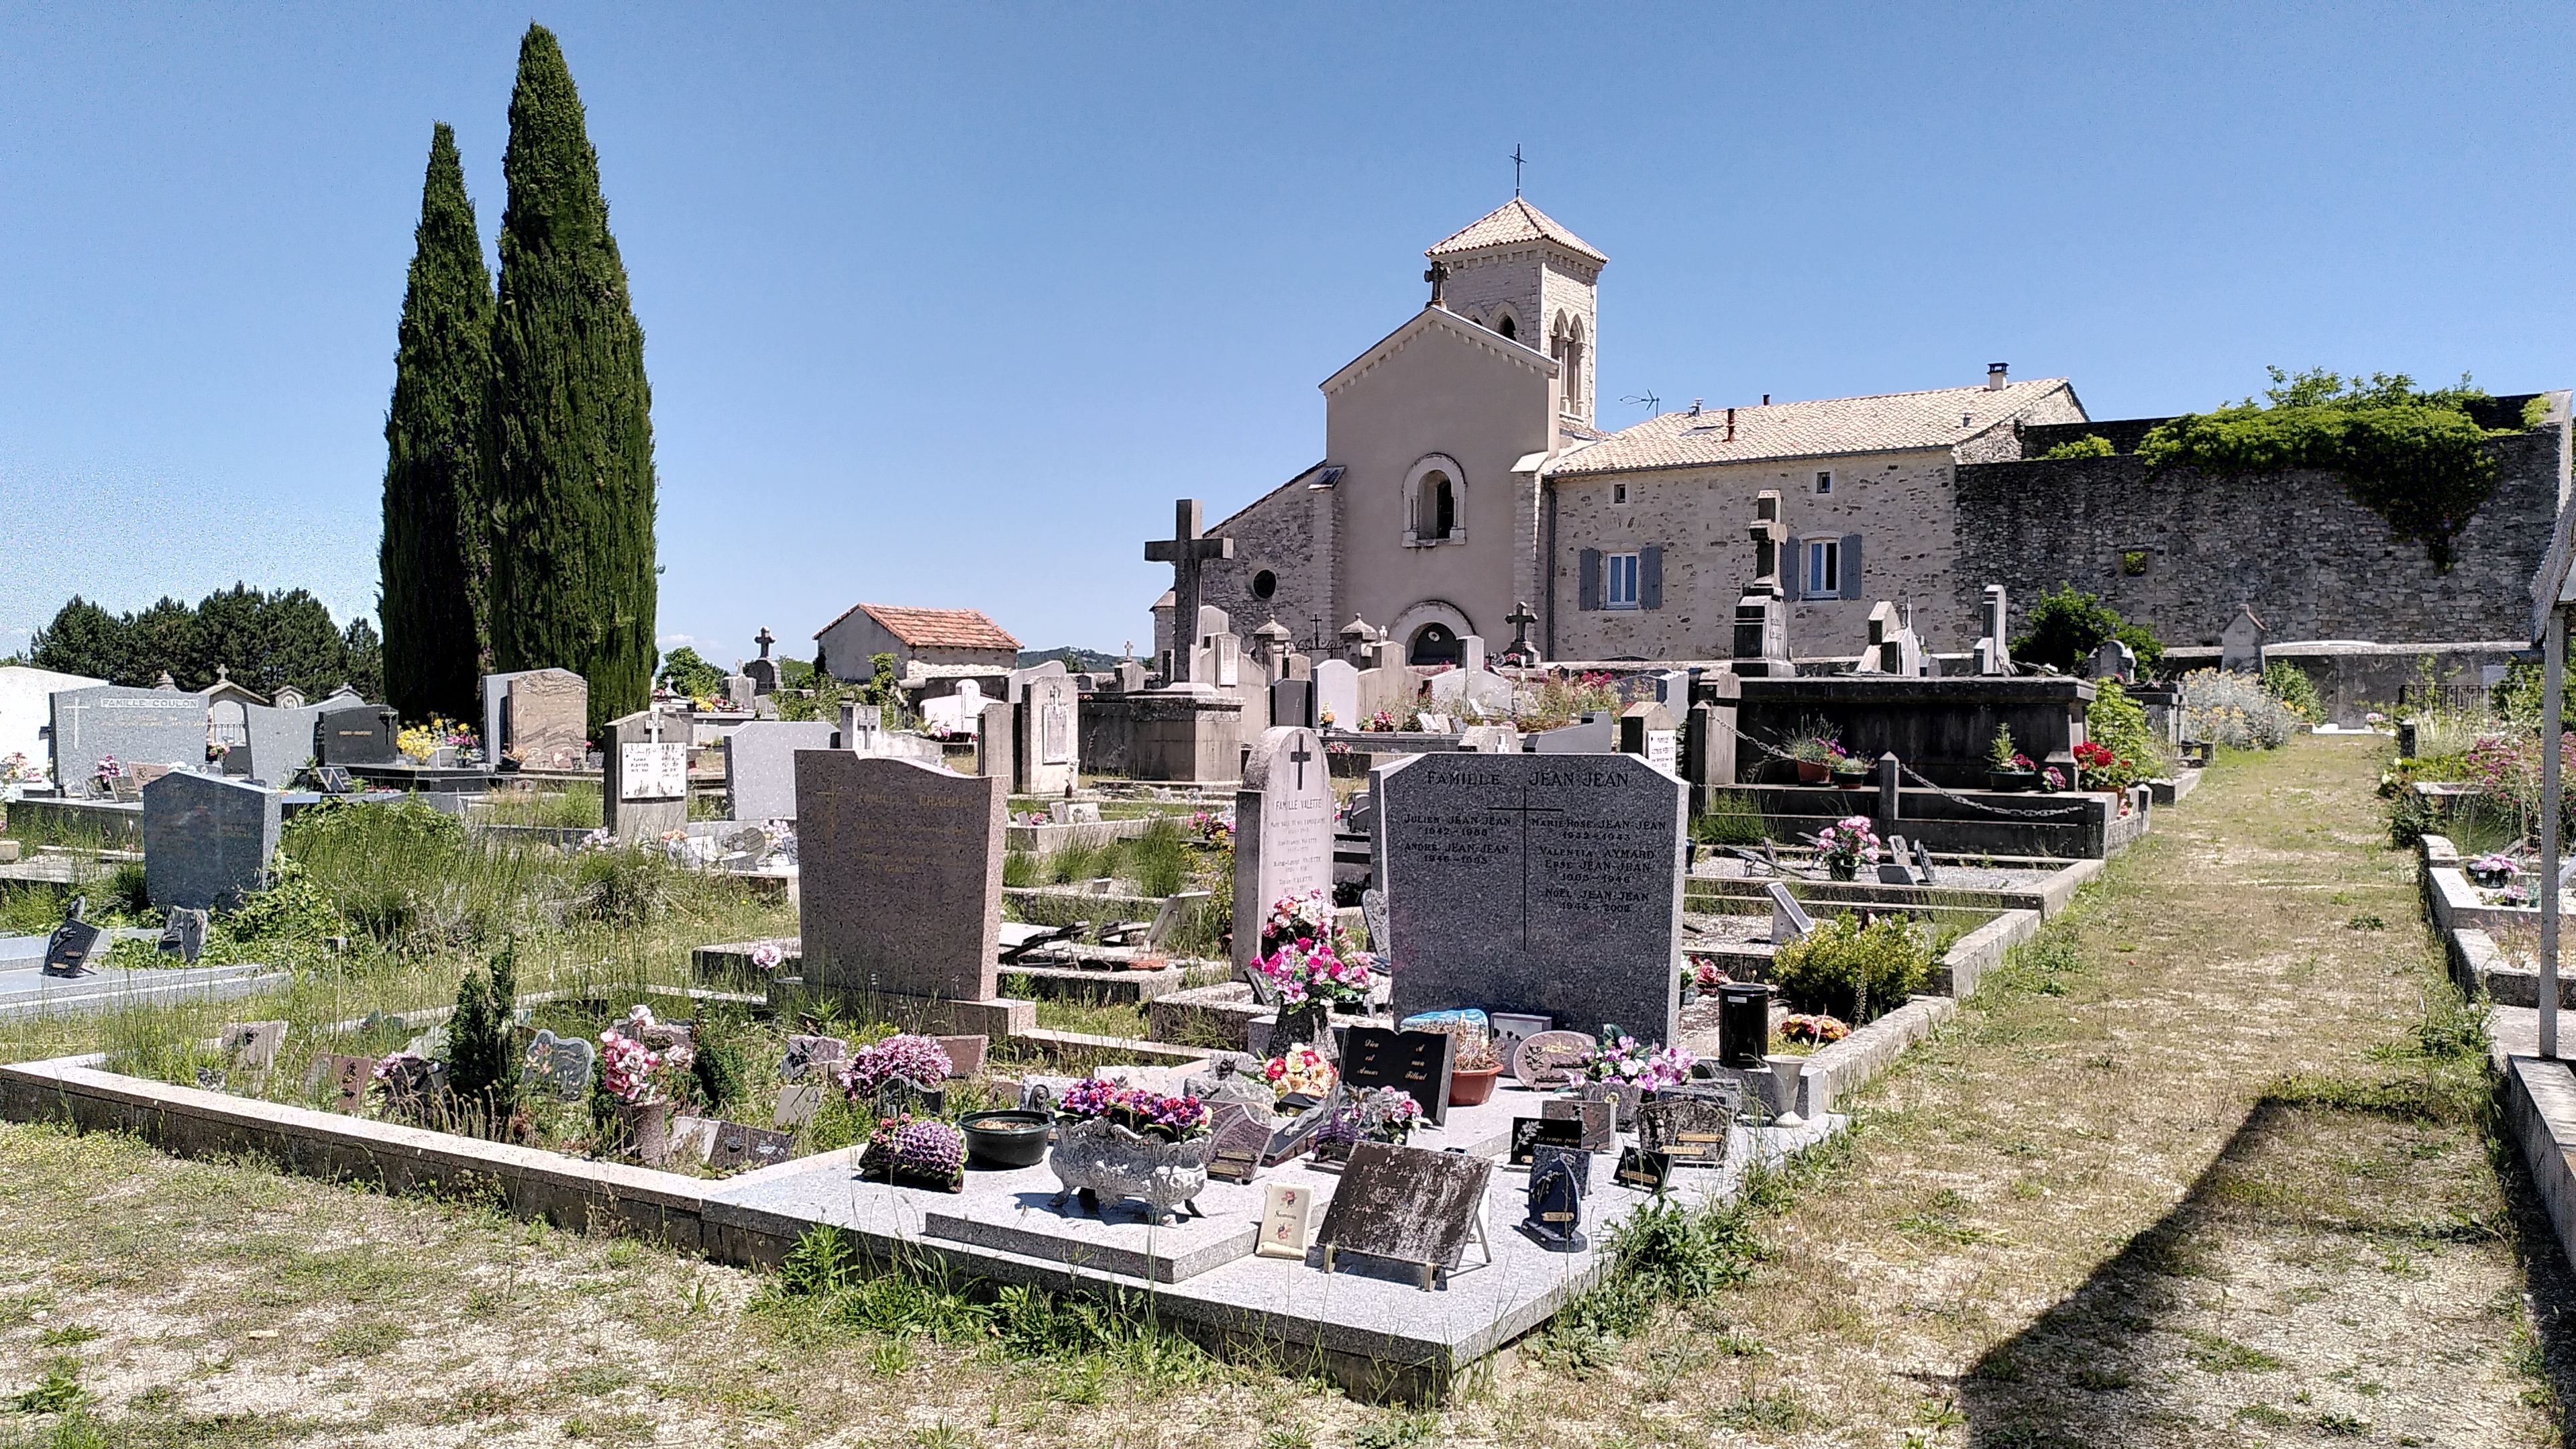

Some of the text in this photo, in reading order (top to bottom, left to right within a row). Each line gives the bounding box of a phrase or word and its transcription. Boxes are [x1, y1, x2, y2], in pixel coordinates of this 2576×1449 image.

[102, 699, 197, 708] FAMILLE COULON
[1427, 771, 1500, 785] FAMILLE
[1301, 798, 1322, 809] VALETTE
[1404, 814, 1440, 824] JULIEN
[1604, 849, 1654, 859] AYMARD
[1364, 1039, 1379, 1048] Dieu
[1357, 1066, 1379, 1075] Amour
[1275, 1210, 1297, 1220] Souvenir
